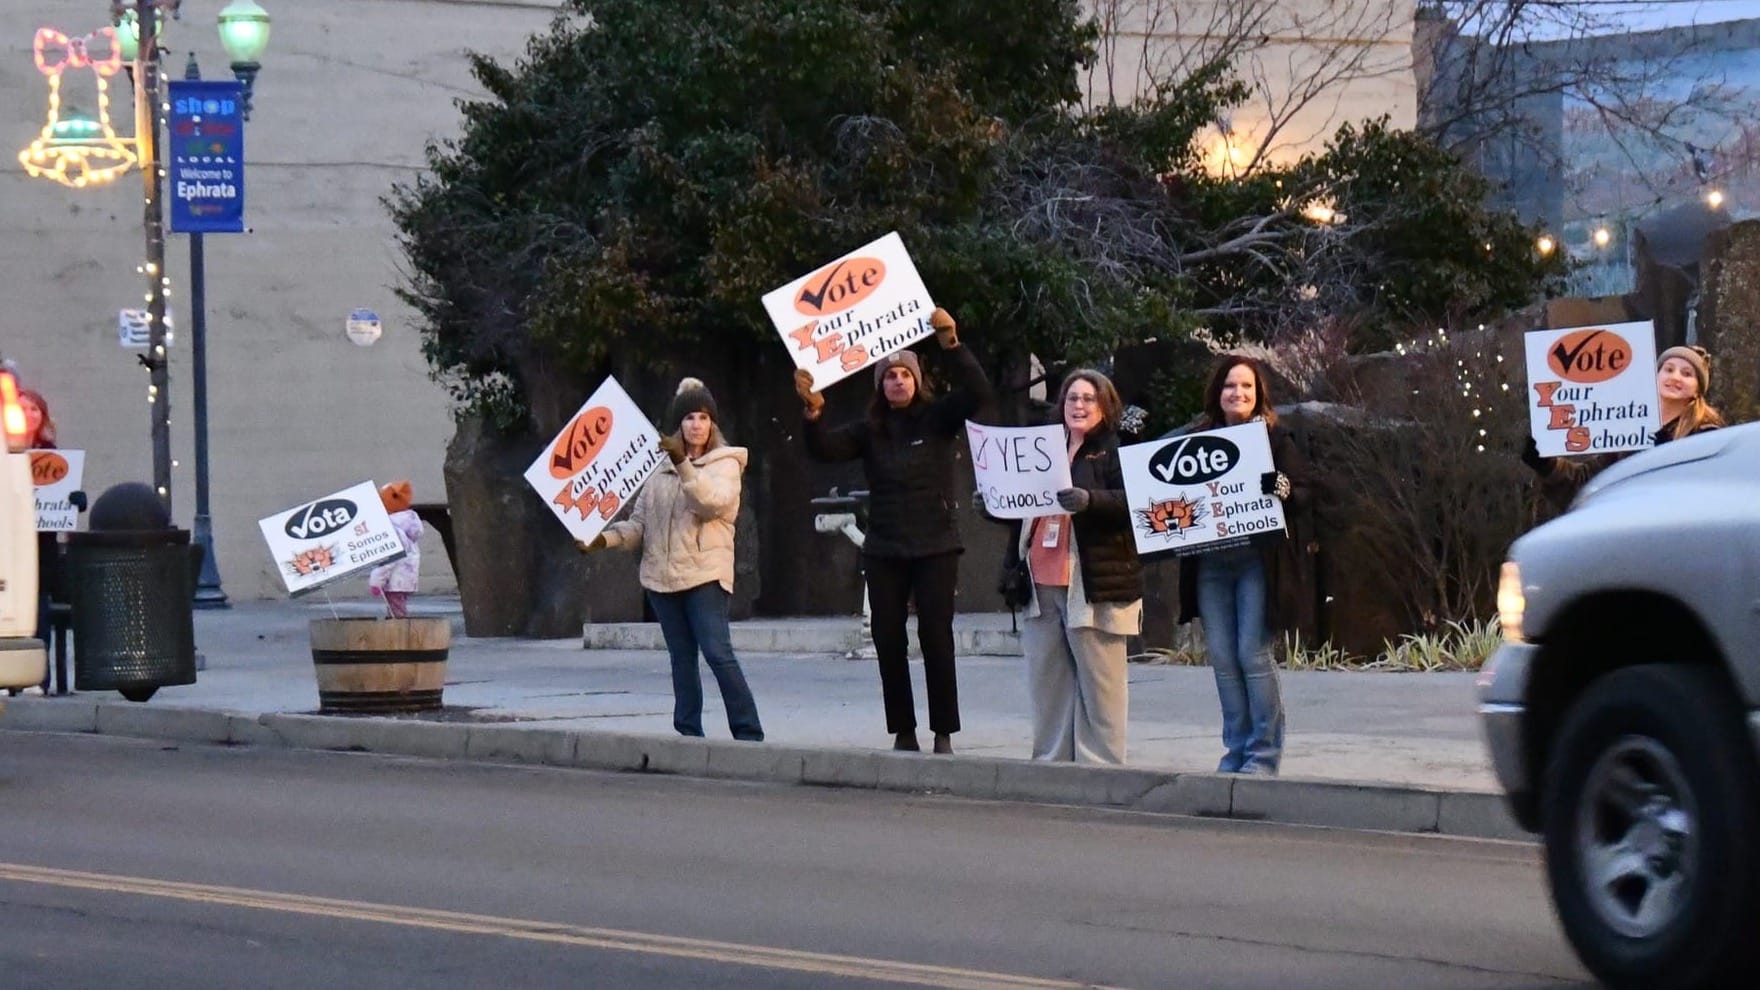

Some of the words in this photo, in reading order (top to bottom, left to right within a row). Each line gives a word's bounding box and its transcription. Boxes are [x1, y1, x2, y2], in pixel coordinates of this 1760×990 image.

[175, 97, 235, 116] shop
[177, 156, 236, 164] LOCAL
[180, 168, 221, 179] Welcome
[222, 169, 233, 180] to
[177, 181, 236, 201] Ephrata
[799, 260, 877, 311] Vote
[789, 309, 854, 351] Your
[813, 299, 920, 364] Ephrata
[840, 316, 932, 373] Schools
[1553, 329, 1624, 374] Vote
[1534, 381, 1593, 408] Your
[1547, 400, 1648, 430] Ephrata
[553, 413, 607, 471] Vote
[995, 437, 1052, 473] YES
[1565, 426, 1656, 452] Schools
[1156, 437, 1229, 482] Vote
[553, 460, 600, 514] Your
[574, 433, 648, 521] Ephrata
[597, 448, 663, 521] Schools
[1206, 481, 1245, 497] Your
[291, 503, 351, 538] Vota
[1211, 498, 1273, 518] Ephrata
[347, 532, 389, 551] Somos
[1216, 516, 1278, 537] Schools
[350, 540, 397, 563] Ephrata
